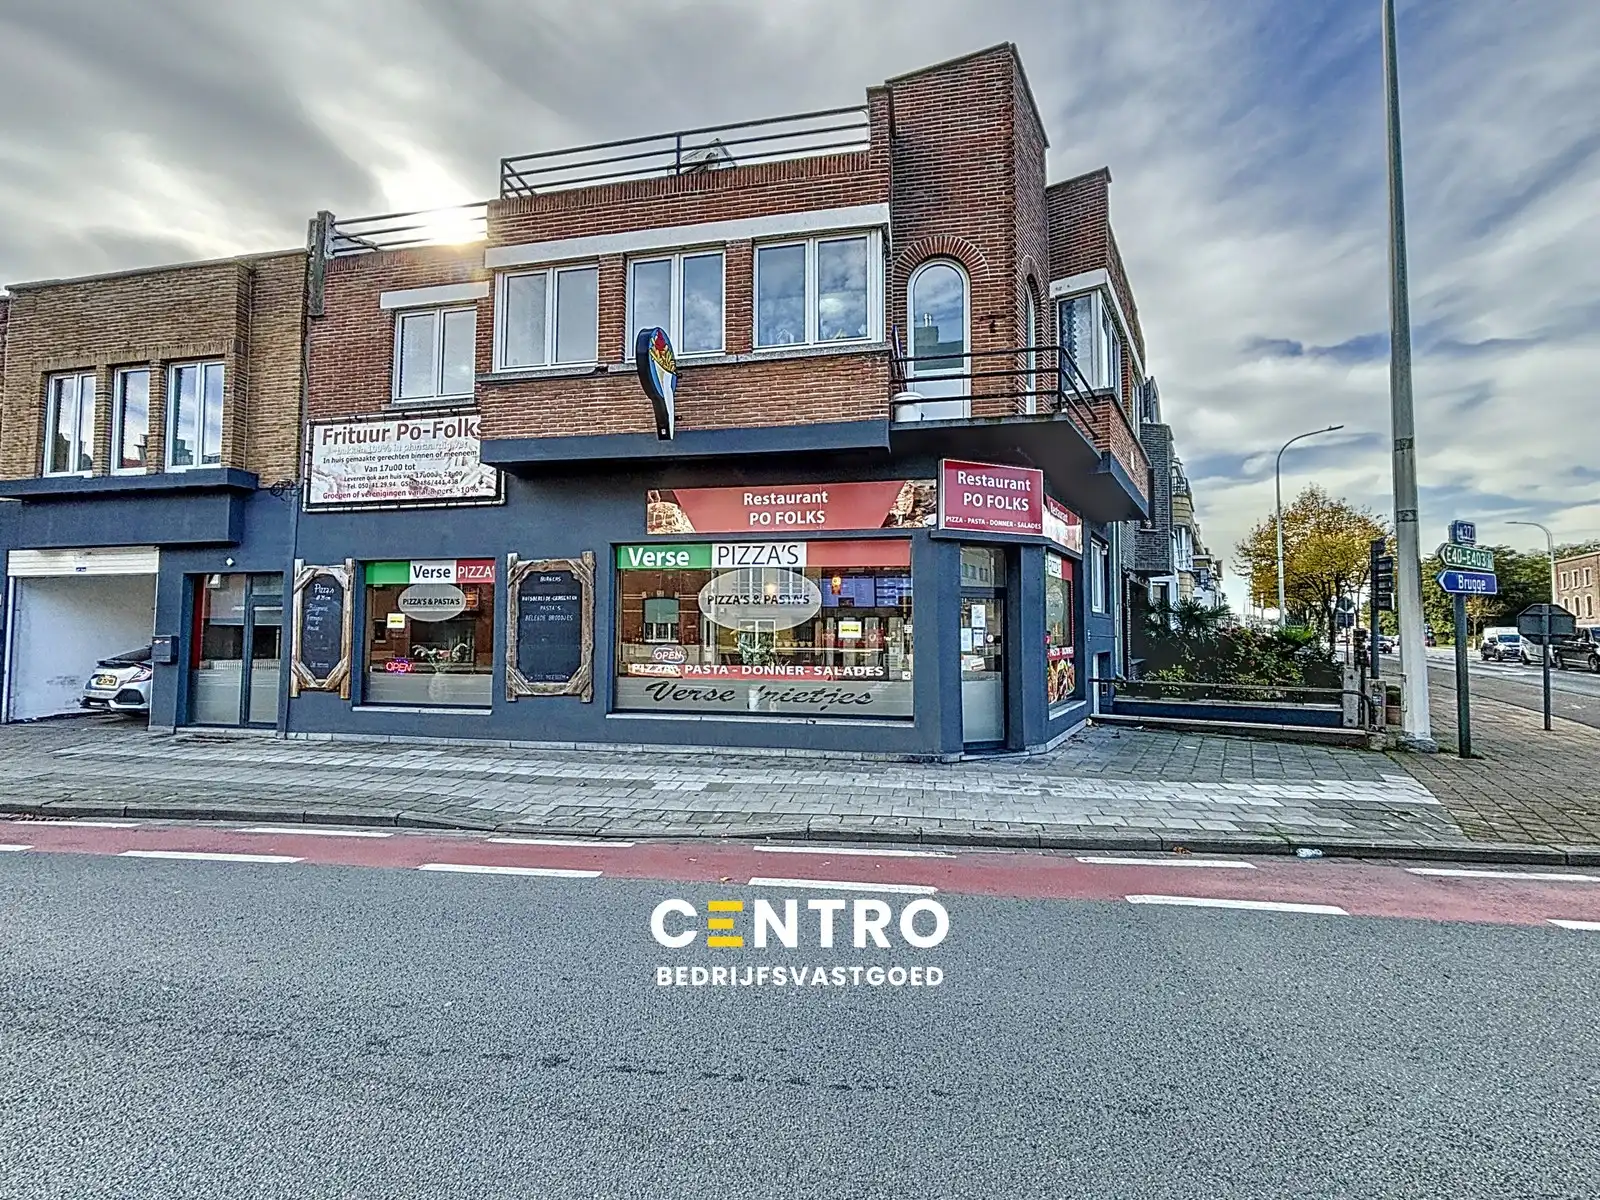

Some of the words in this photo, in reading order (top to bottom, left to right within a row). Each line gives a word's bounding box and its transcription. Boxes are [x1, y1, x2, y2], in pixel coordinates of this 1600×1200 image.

[322, 426, 390, 446] Frituur
[346, 455, 375, 464] gemaakte
[377, 453, 409, 463] gerechten
[364, 465, 377, 473] Van
[380, 464, 403, 472] 17u00
[404, 463, 416, 471] tot
[957, 470, 1031, 491] Restaurant
[352, 490, 360, 498] of
[361, 490, 406, 499] verenigingen
[743, 491, 829, 506] Restaurant
[963, 492, 983, 507] PO
[987, 494, 1030, 511] FOLKS
[749, 512, 771, 526] PO
[775, 510, 826, 525] FOLKS
[946, 515, 963, 523] PIZZA
[967, 517, 985, 525] PASTA
[989, 519, 1014, 527] DONNER
[1017, 521, 1042, 530] SALADES
[628, 547, 690, 567] Verse
[718, 544, 799, 566] PIZZA'S
[1446, 546, 1487, 567] E40-E403
[413, 565, 451, 579] Verse
[1458, 574, 1487, 592] Brugge
[402, 597, 427, 606] PIZZA'S
[434, 597, 460, 606] PASTA'S
[707, 595, 749, 606] PIZZA'S
[753, 595, 761, 605] &
[764, 594, 810, 605] PASTA'S
[654, 650, 682, 661] OPEN
[385, 661, 413, 672] OPEN
[685, 664, 728, 675] PASTA
[814, 665, 884, 677] SALADES
[645, 680, 736, 702] Verse
[747, 685, 874, 711] rietjes
